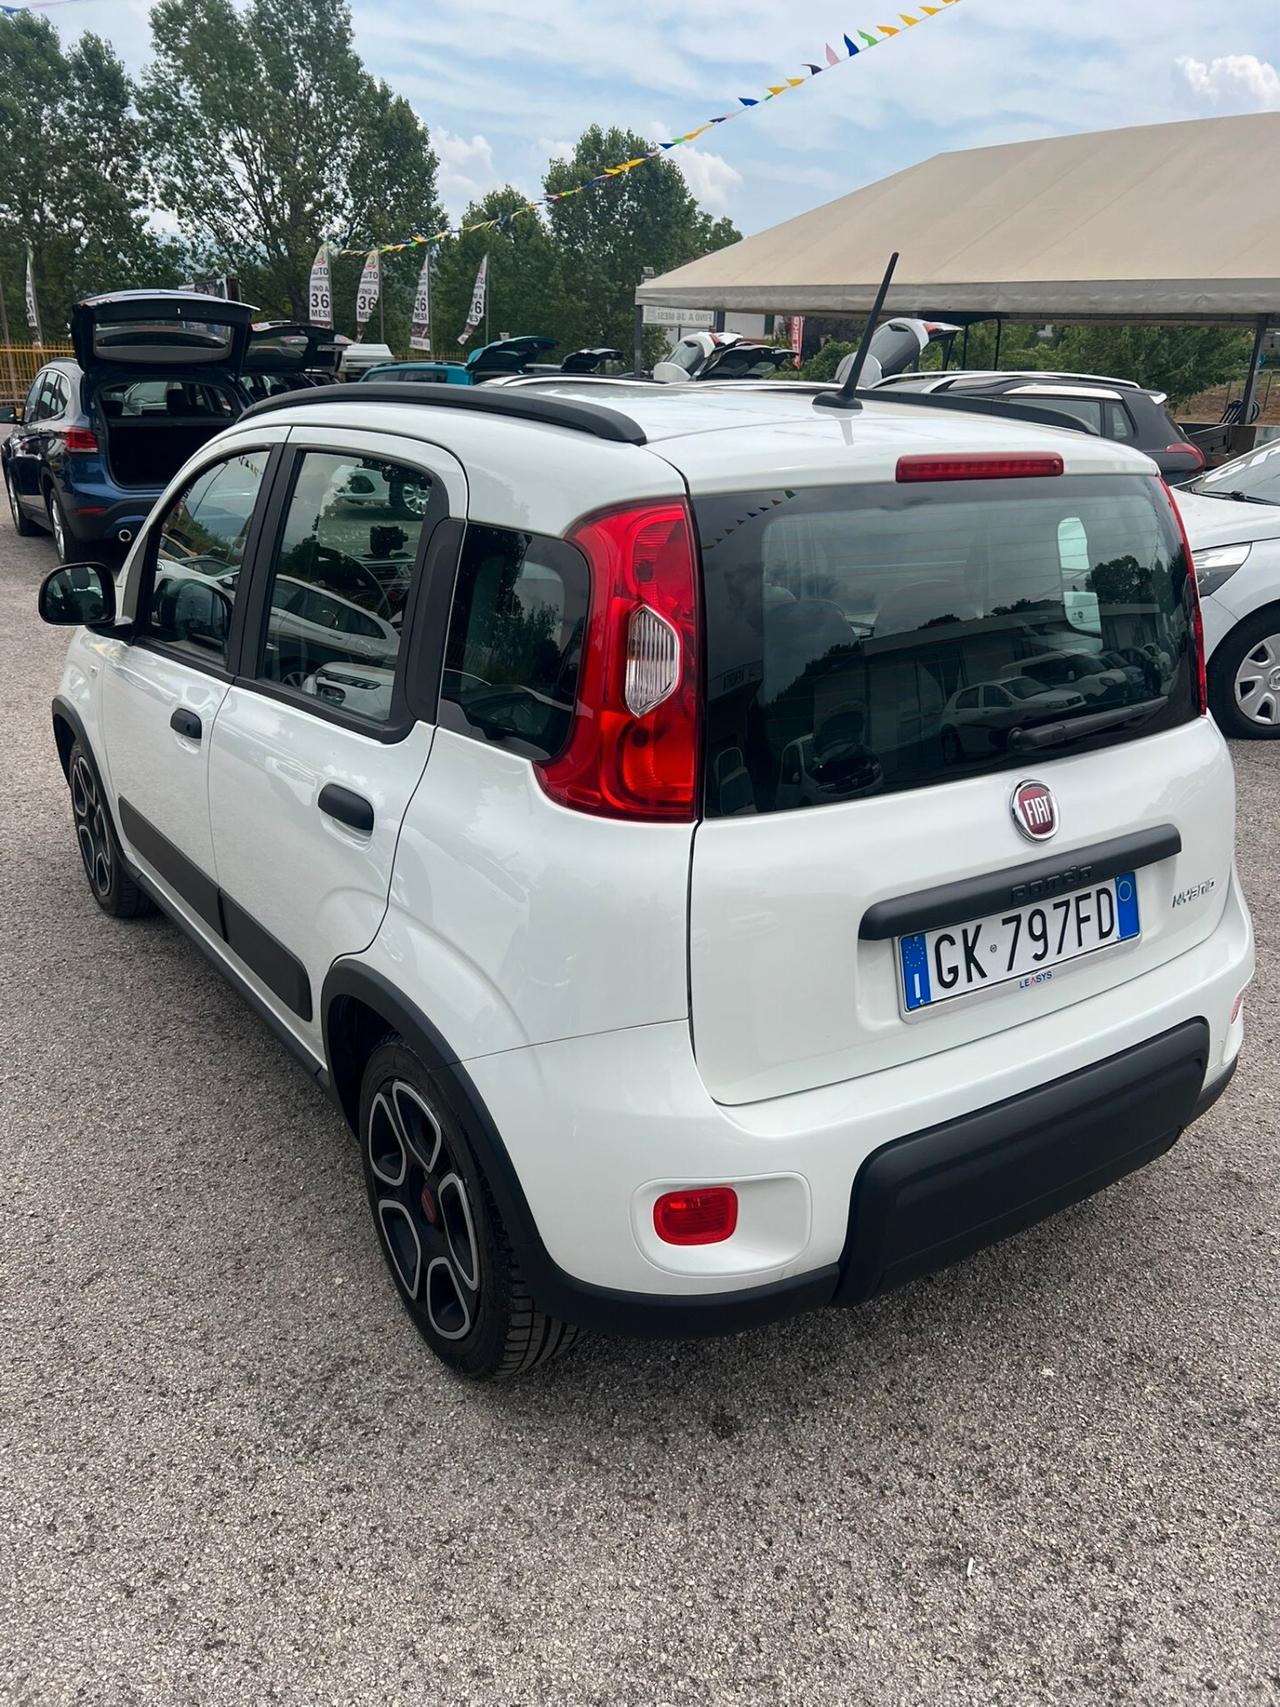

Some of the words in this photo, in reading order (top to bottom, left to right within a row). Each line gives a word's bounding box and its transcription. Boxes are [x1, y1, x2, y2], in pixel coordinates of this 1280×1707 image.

[311, 293, 330, 309] 36
[358, 296, 377, 311] 36
[311, 309, 330, 318] MESI
[1023, 795, 1053, 826] FIAT
[934, 923, 988, 989] GK
[1001, 887, 1115, 972] 797FD
[1019, 971, 1053, 990] LEASYS
